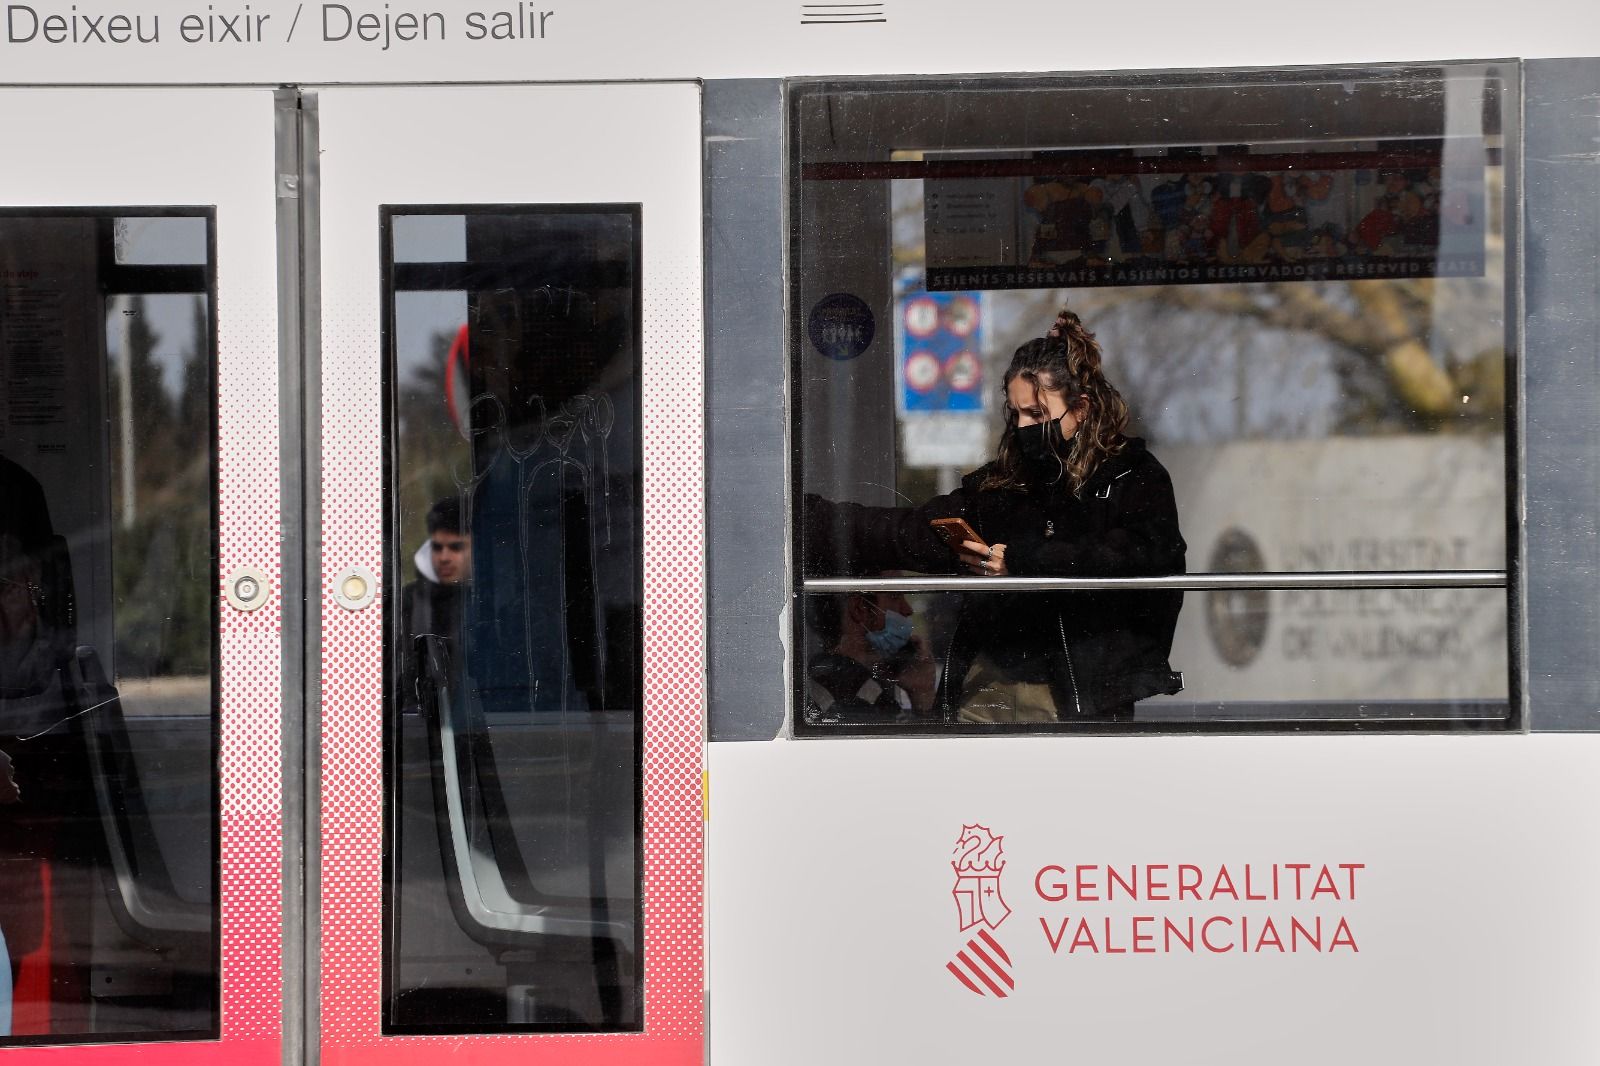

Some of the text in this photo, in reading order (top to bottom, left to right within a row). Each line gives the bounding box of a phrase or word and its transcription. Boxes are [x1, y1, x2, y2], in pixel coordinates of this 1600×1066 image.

[8, 4, 160, 43] Deixeu
[179, 5, 271, 43] eixir
[322, 3, 446, 50] Dejen
[465, 2, 554, 40] salir
[934, 273, 999, 286] SEIENTS
[1006, 270, 1096, 284] RESERVATS
[1117, 268, 1200, 281] ASIENTOS
[1207, 265, 1315, 279] RESERVADOS
[1336, 262, 1420, 276] RESERVED
[1034, 863, 1366, 903] GENERALITAT
[1039, 915, 1359, 954] VALENCIANA
